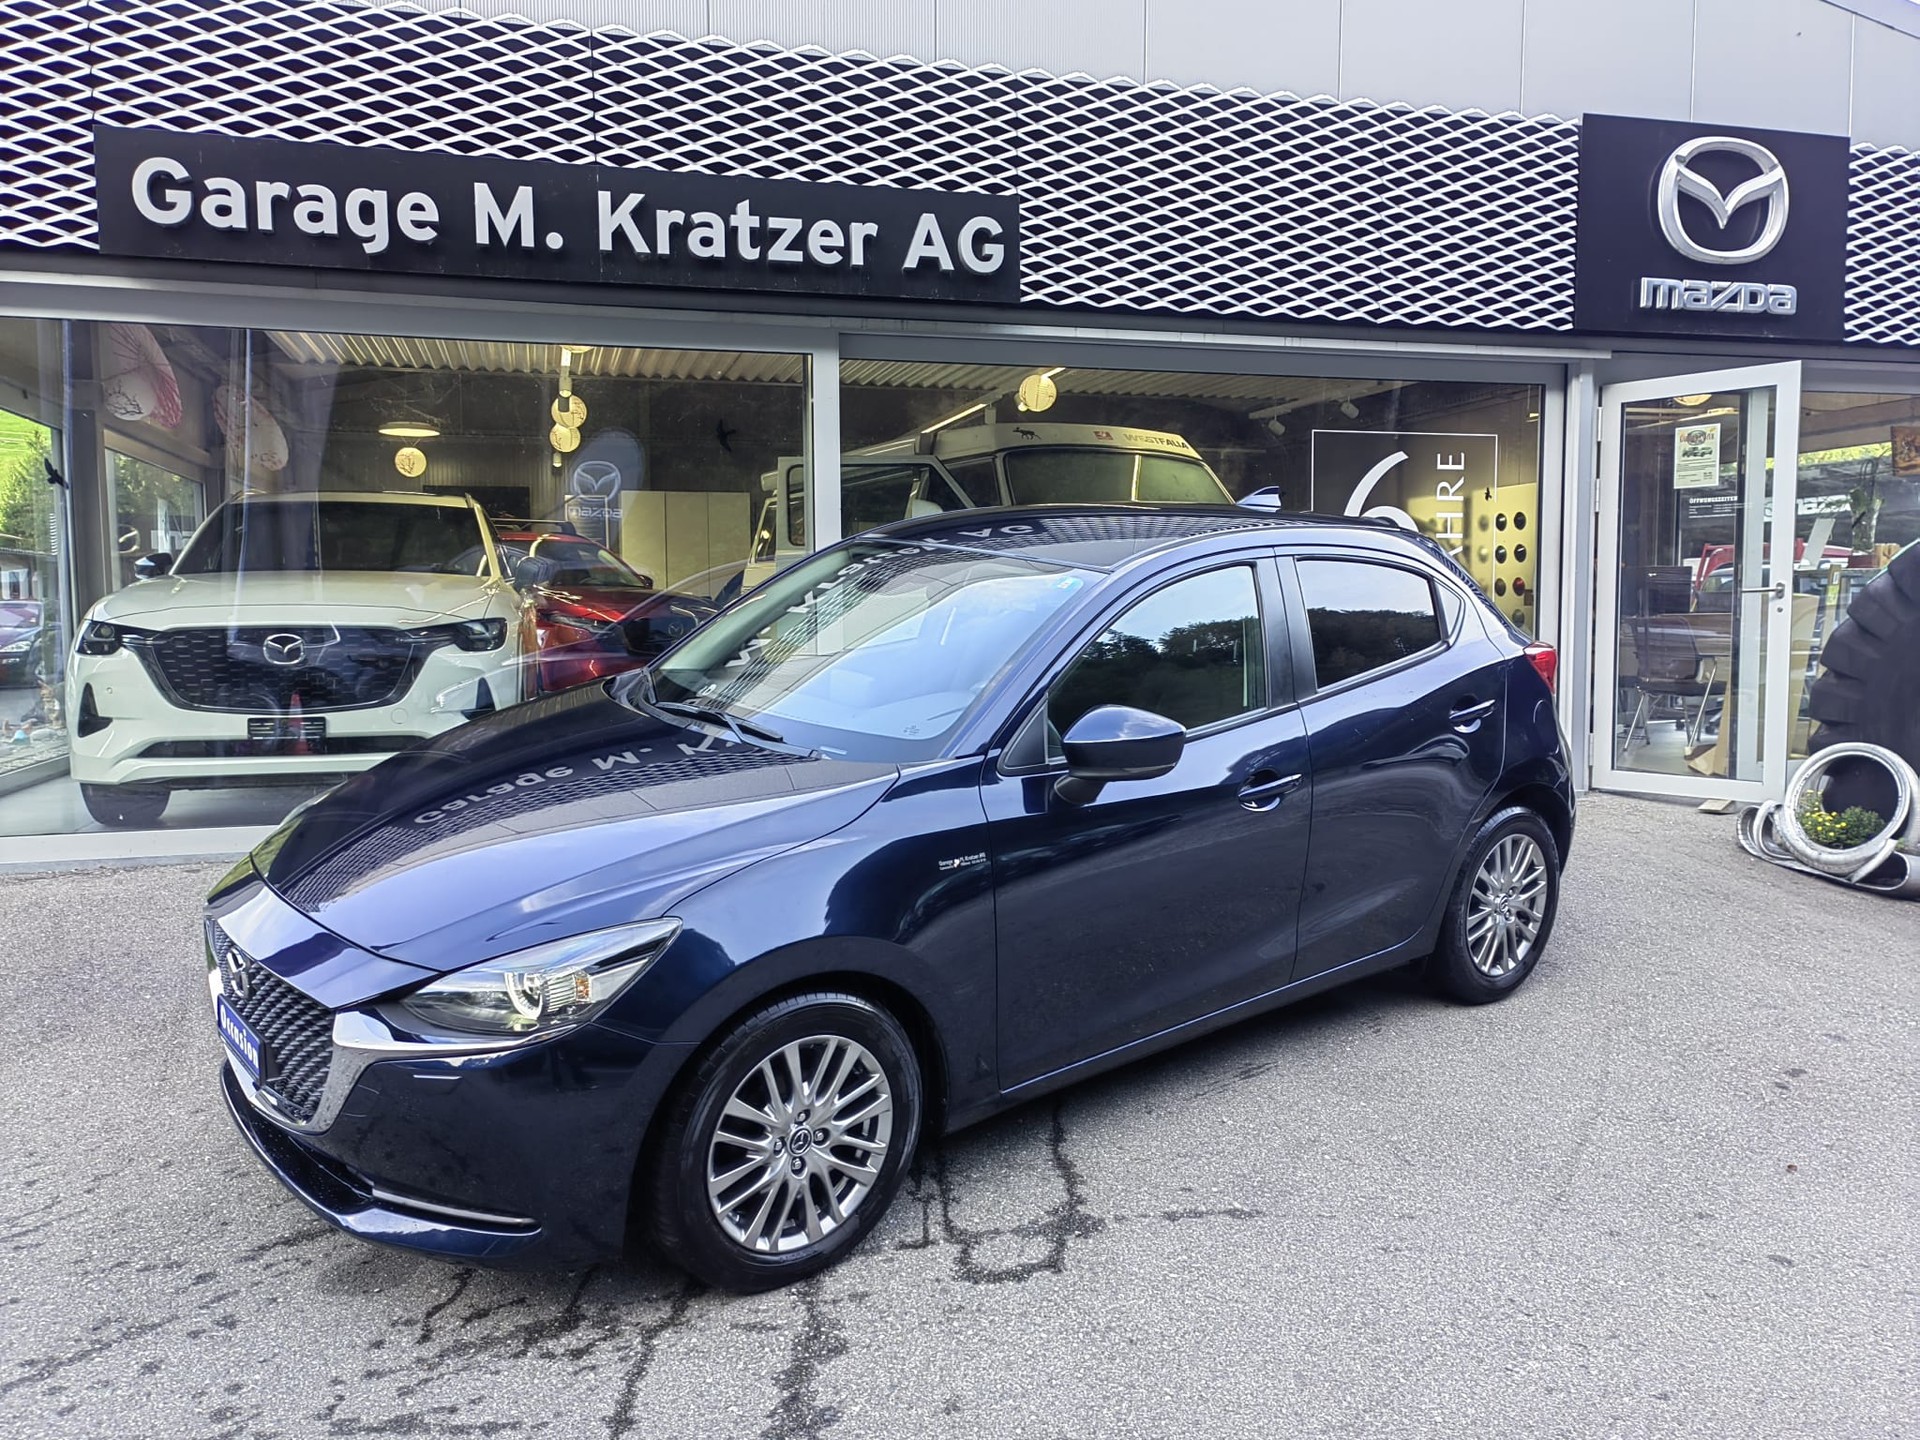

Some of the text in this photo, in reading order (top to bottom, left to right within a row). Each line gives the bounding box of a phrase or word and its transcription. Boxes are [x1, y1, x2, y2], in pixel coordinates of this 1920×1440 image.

[131, 156, 1006, 274] Garage M. Kratzer AG
[1639, 276, 1798, 316] mazda
